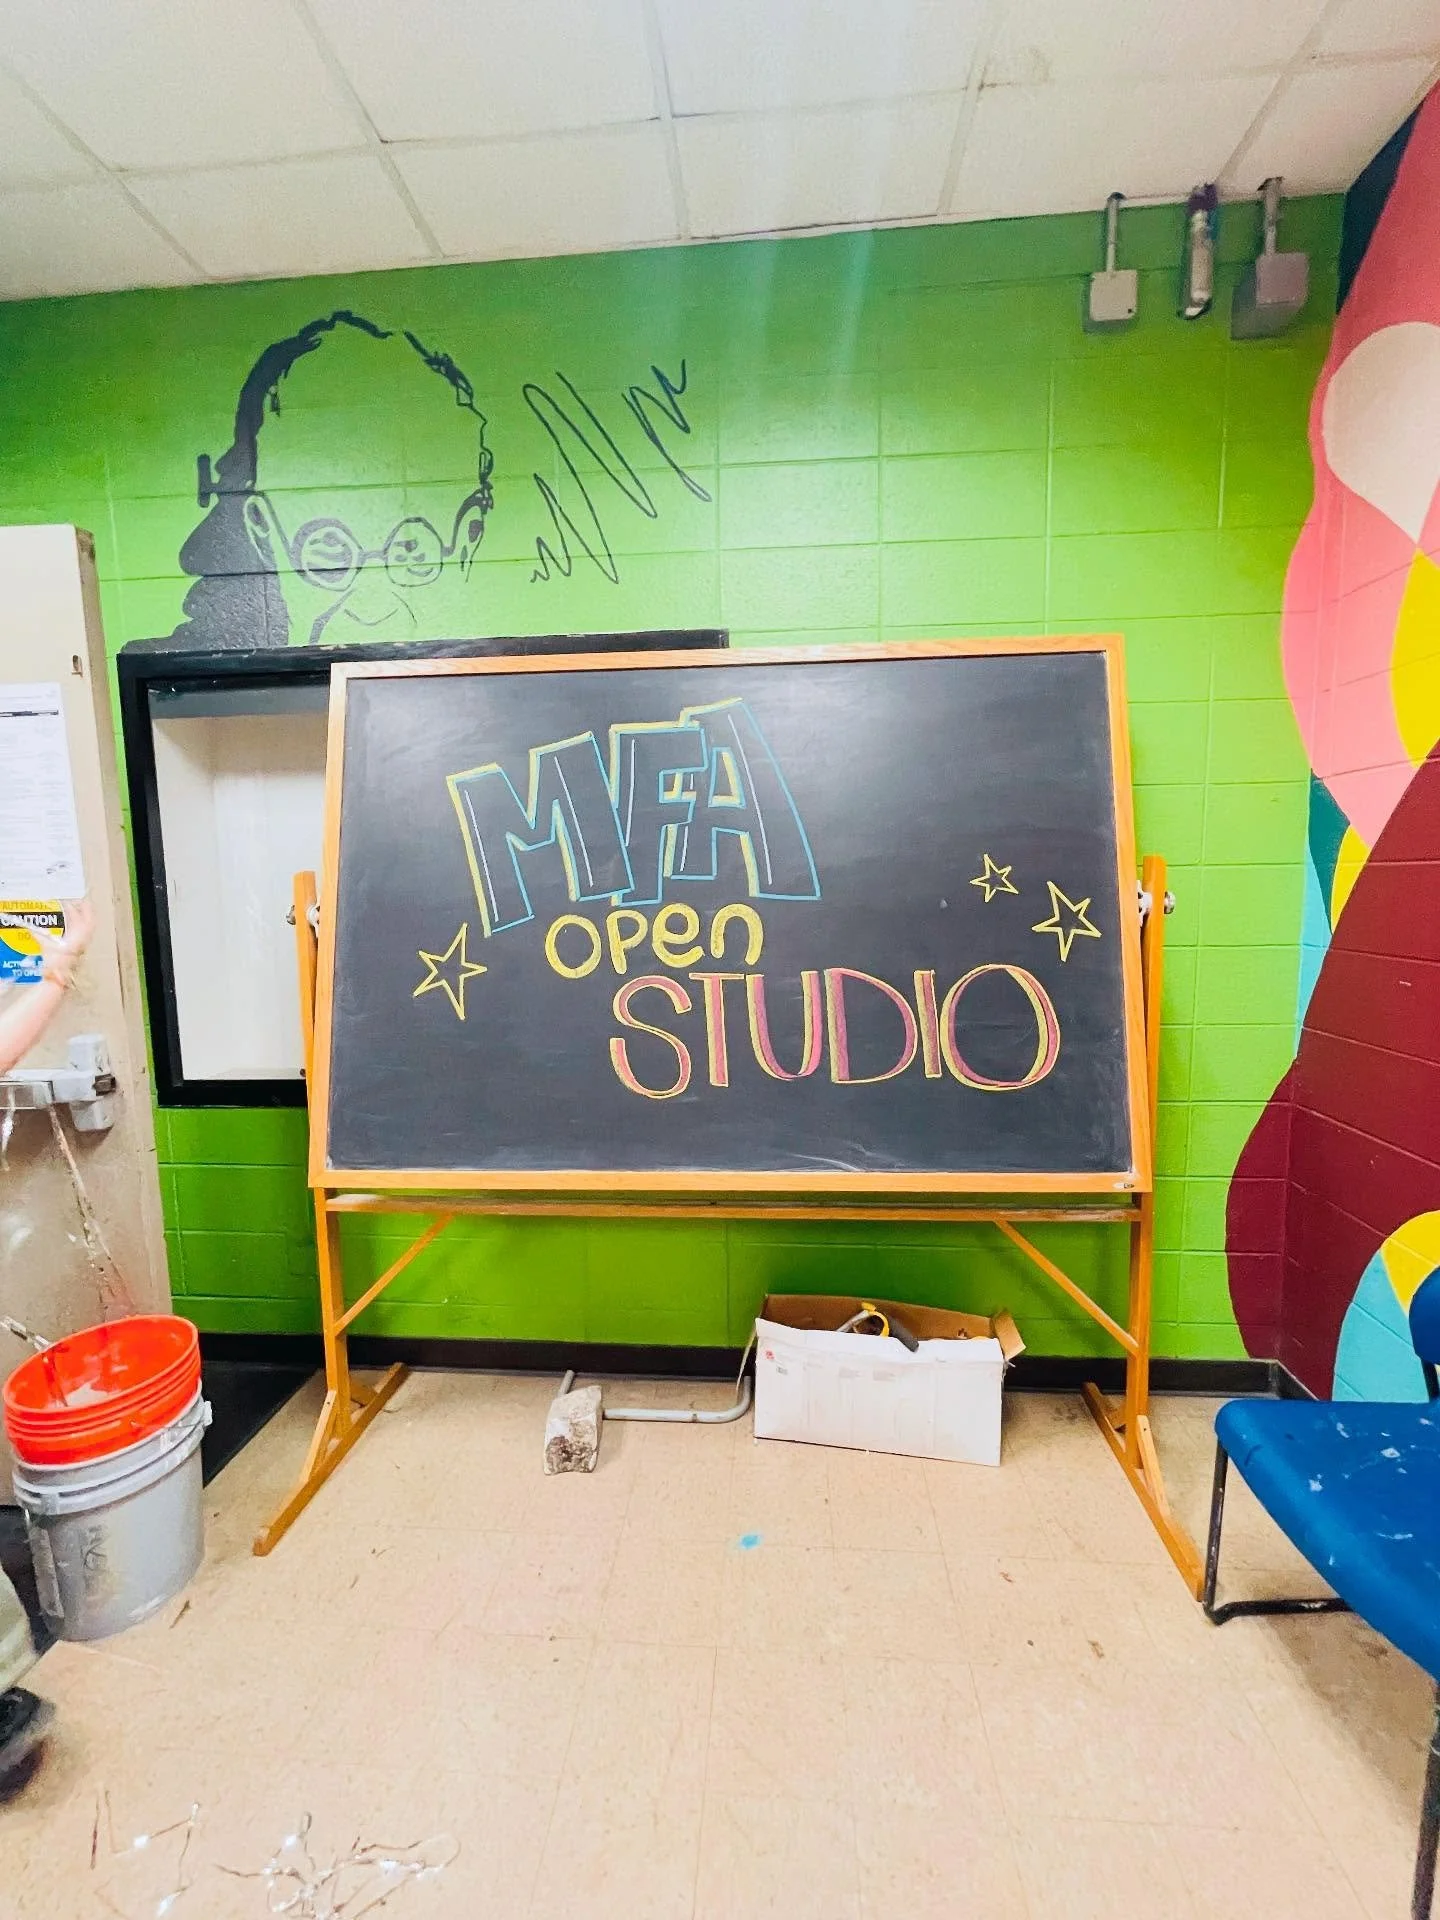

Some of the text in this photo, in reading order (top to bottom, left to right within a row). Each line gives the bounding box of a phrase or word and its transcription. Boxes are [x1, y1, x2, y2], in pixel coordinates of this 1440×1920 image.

[446, 697, 822, 938] MFA
[544, 902, 765, 980] open
[609, 963, 1061, 1099] STUDIO
